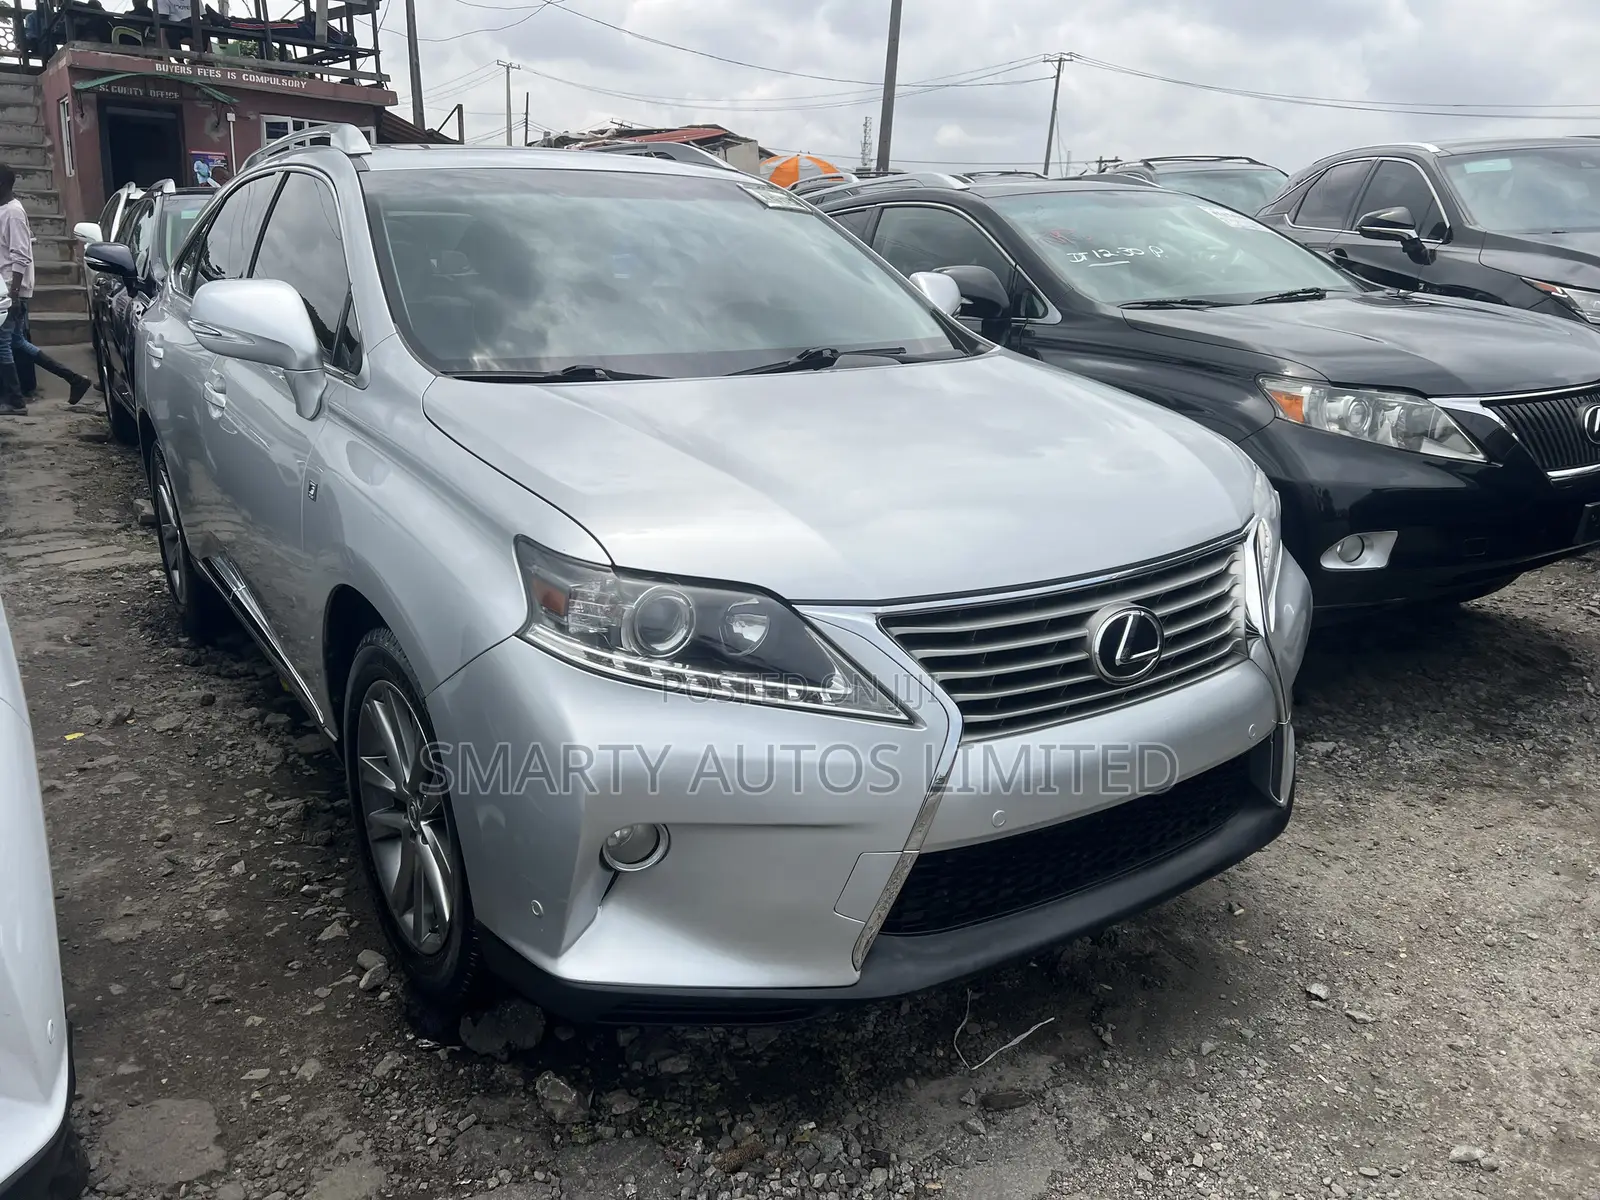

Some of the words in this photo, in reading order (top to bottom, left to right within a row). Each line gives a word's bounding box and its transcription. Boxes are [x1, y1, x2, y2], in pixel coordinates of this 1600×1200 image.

[155, 63, 192, 75] BUYERS
[197, 67, 222, 78] FEES
[227, 71, 237, 80] IS
[242, 73, 307, 89] COMPULSORY
[149, 89, 180, 99] OFFICE
